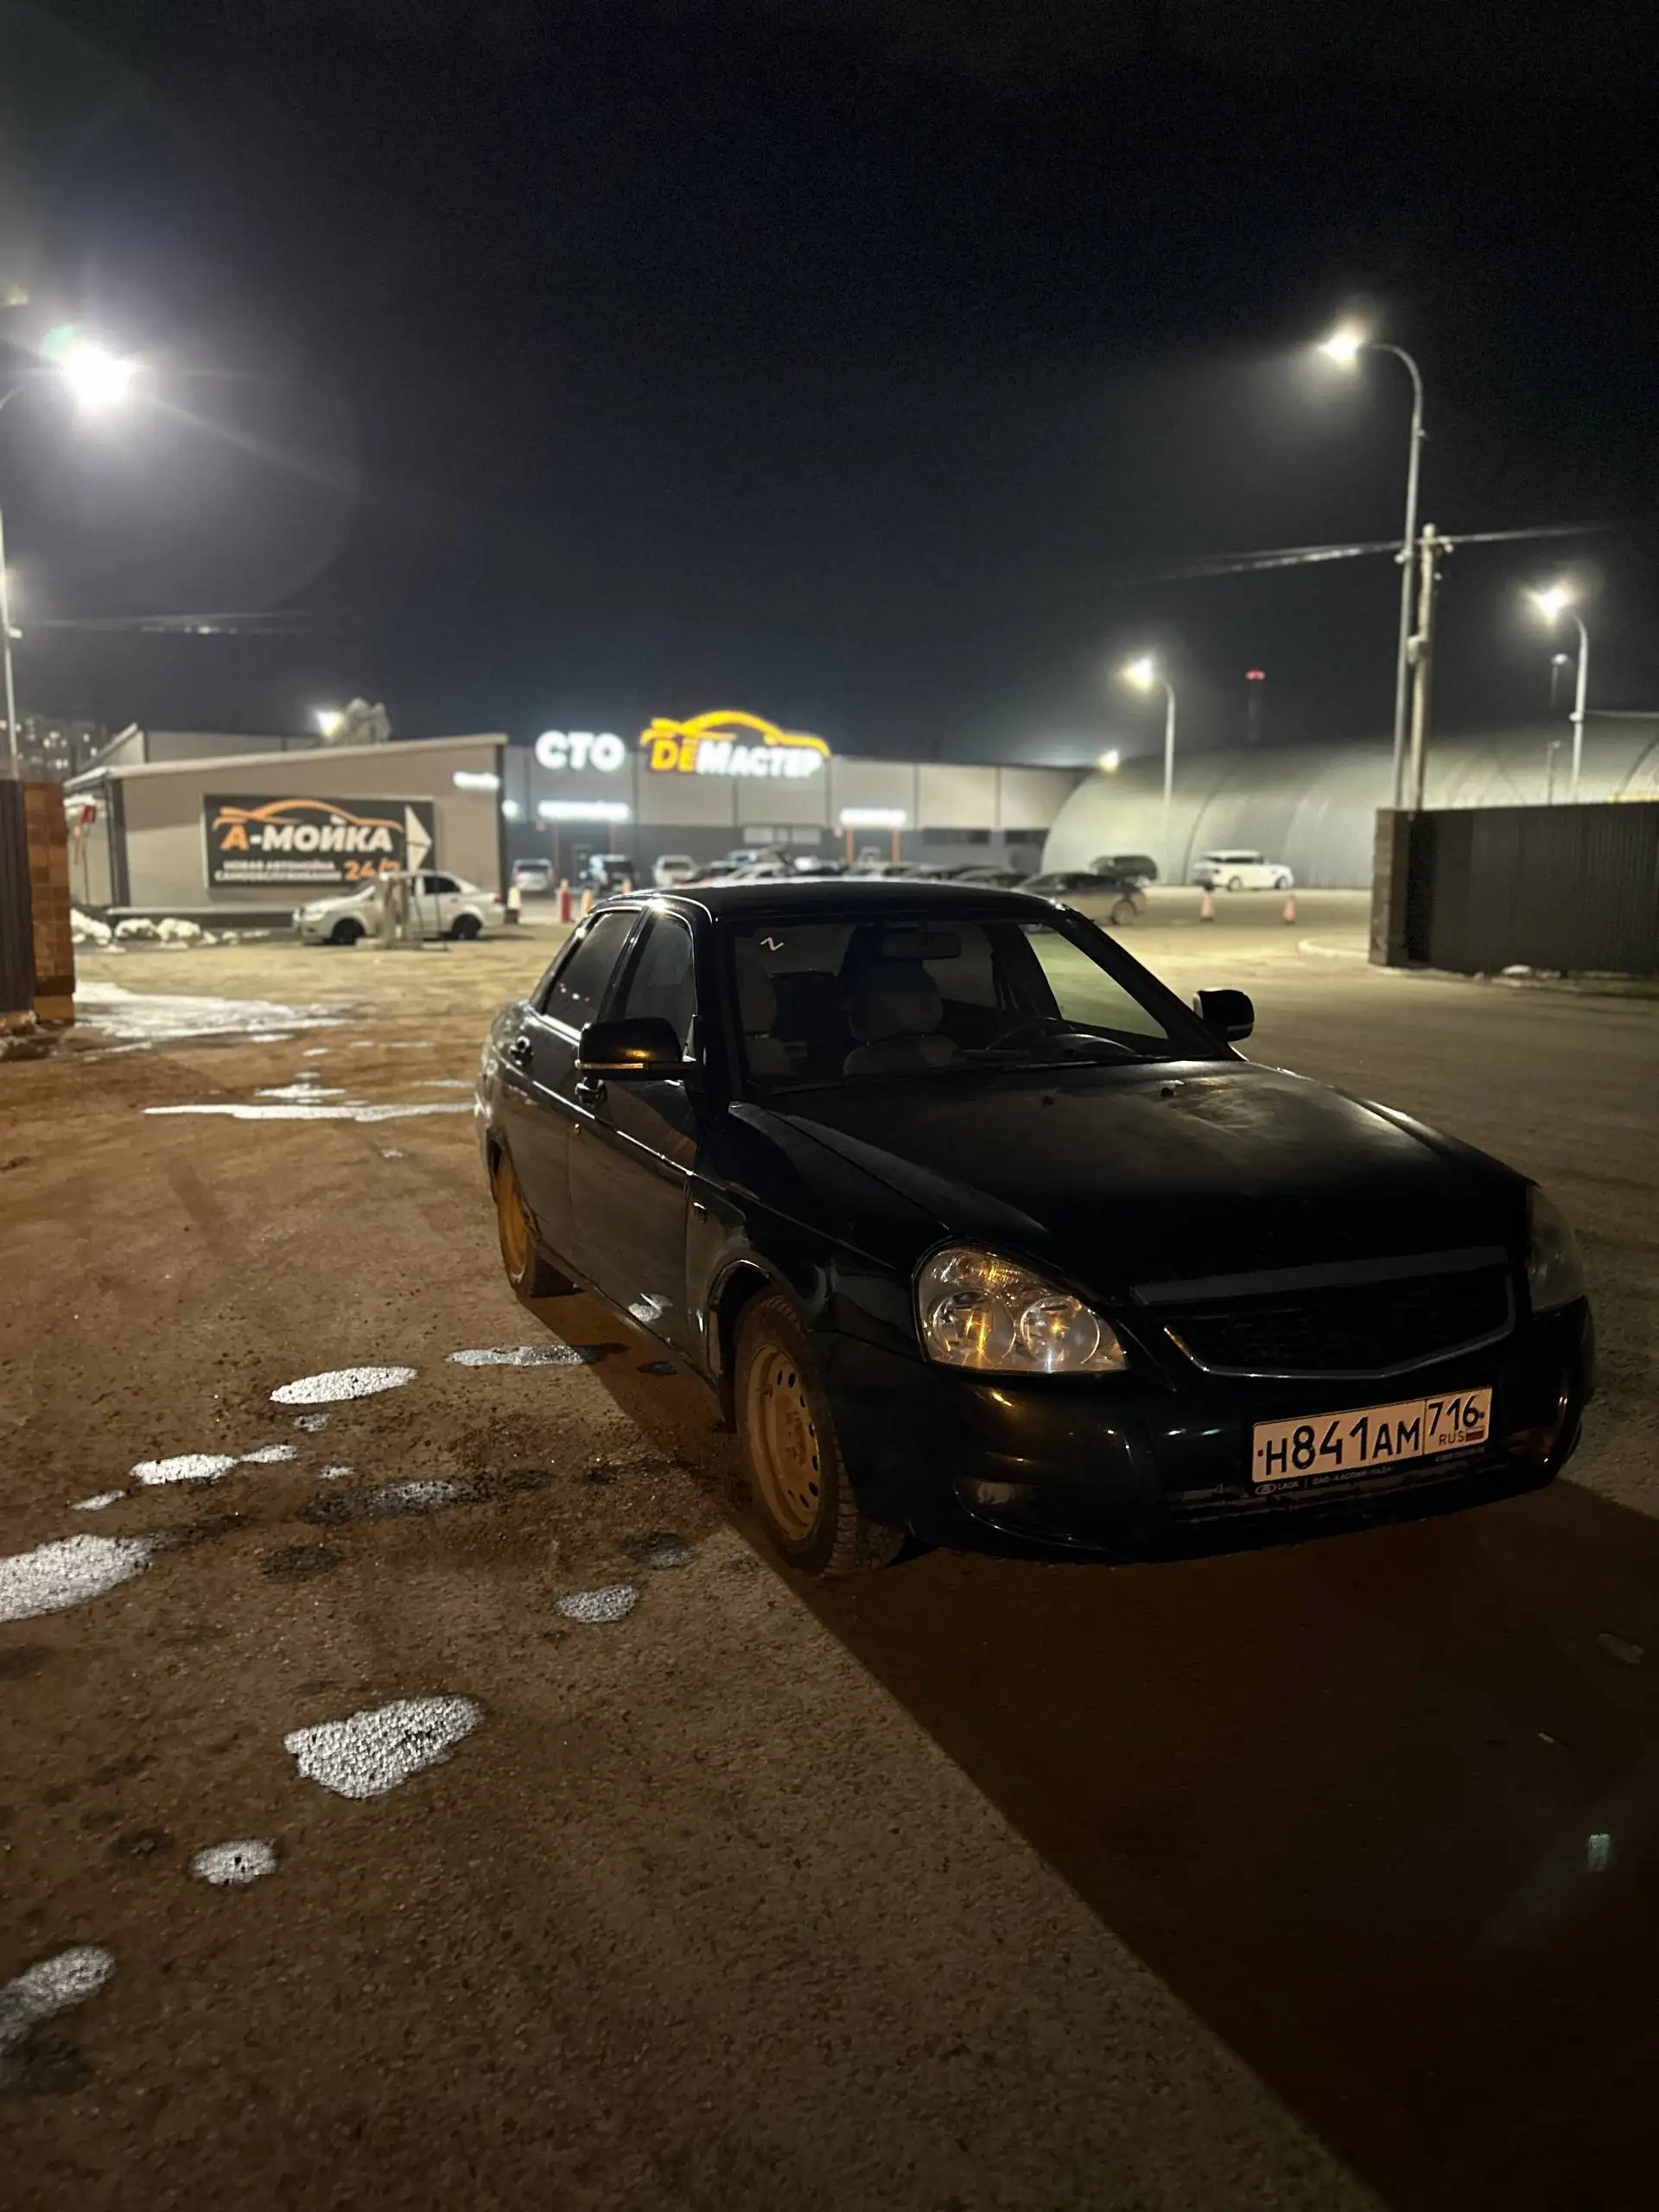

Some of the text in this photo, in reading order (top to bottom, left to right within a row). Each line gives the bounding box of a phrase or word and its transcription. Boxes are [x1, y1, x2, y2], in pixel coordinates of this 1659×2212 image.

[536, 731, 625, 771] СТО
[219, 814, 393, 852] А-МОЙКА
[1265, 1395, 1480, 1476] Н841АМ 716
[1439, 1426, 1465, 1446] RUS
